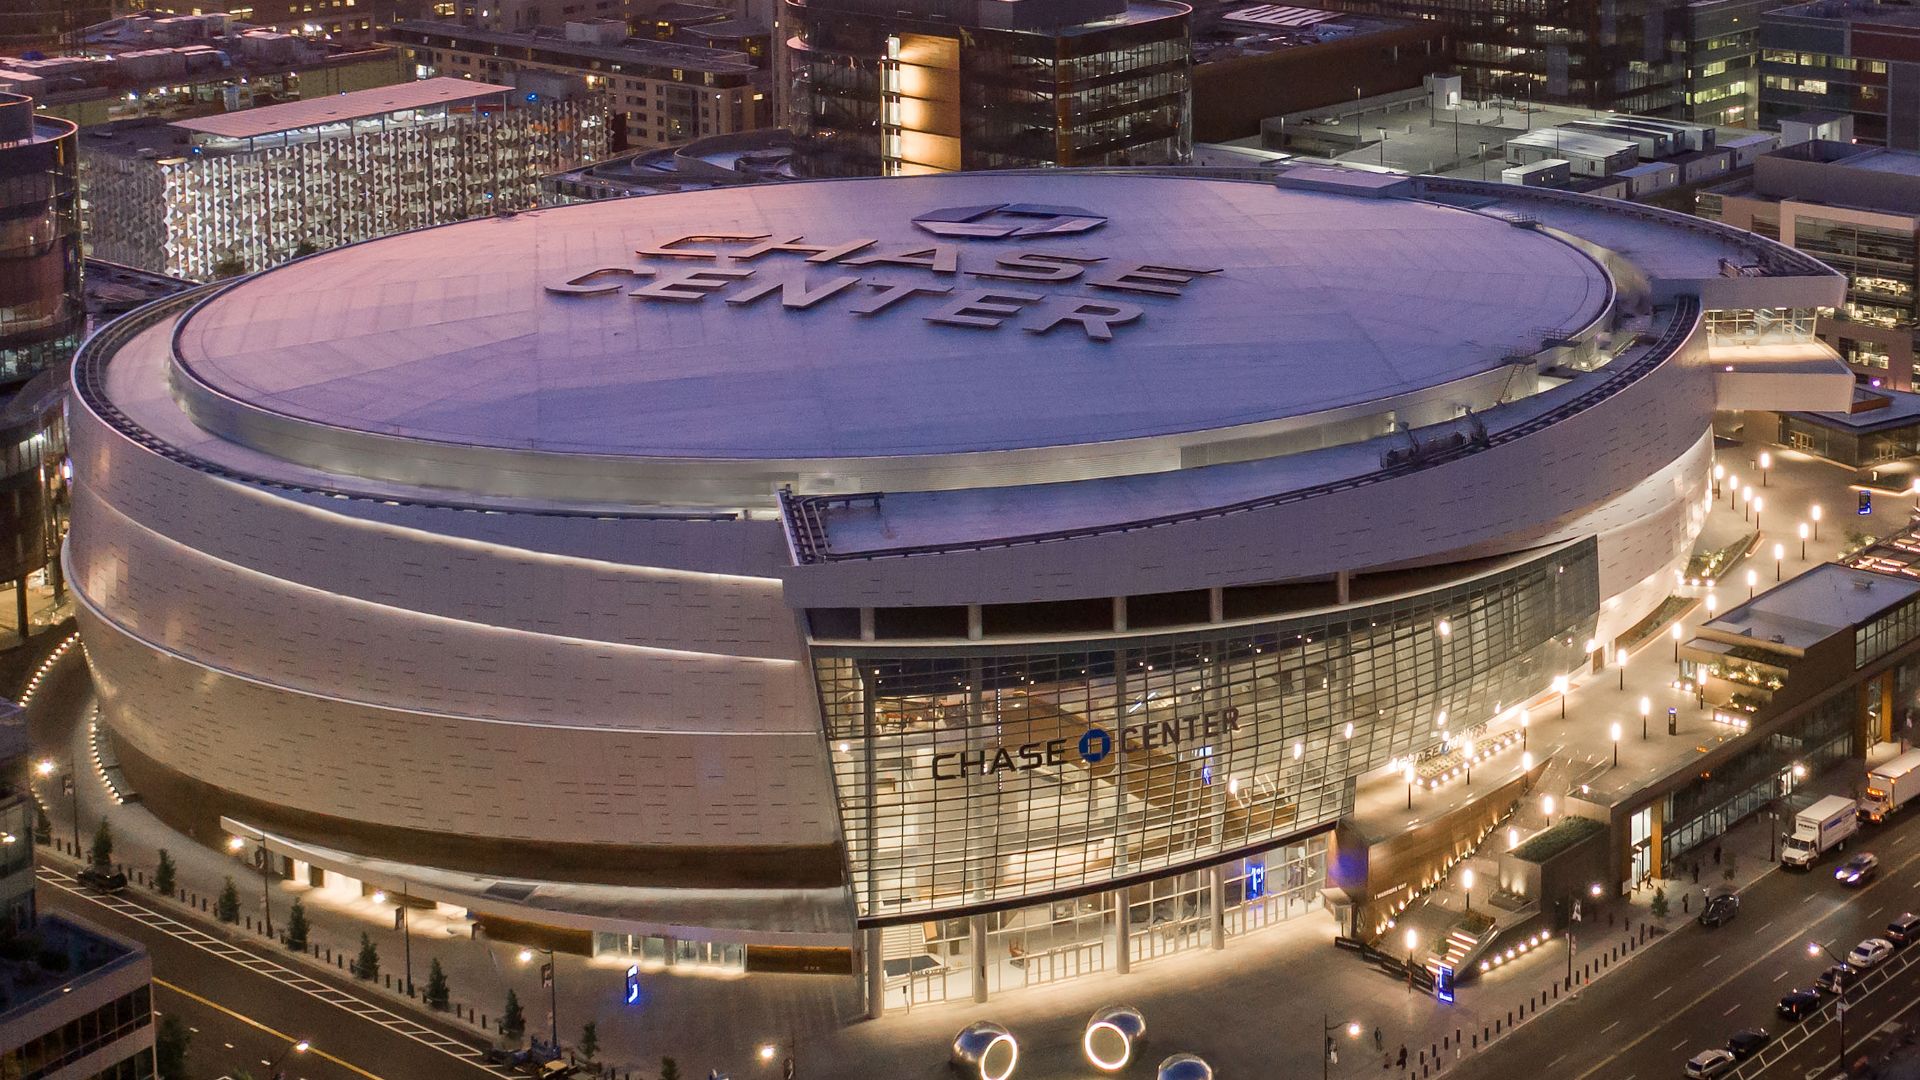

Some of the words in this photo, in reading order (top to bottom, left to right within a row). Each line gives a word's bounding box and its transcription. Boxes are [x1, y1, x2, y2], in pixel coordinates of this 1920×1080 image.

[635, 233, 1225, 297] CHASE
[544, 266, 1146, 341] CENTER
[931, 738, 1070, 781] CHASE
[1120, 705, 1241, 751] CENTER
